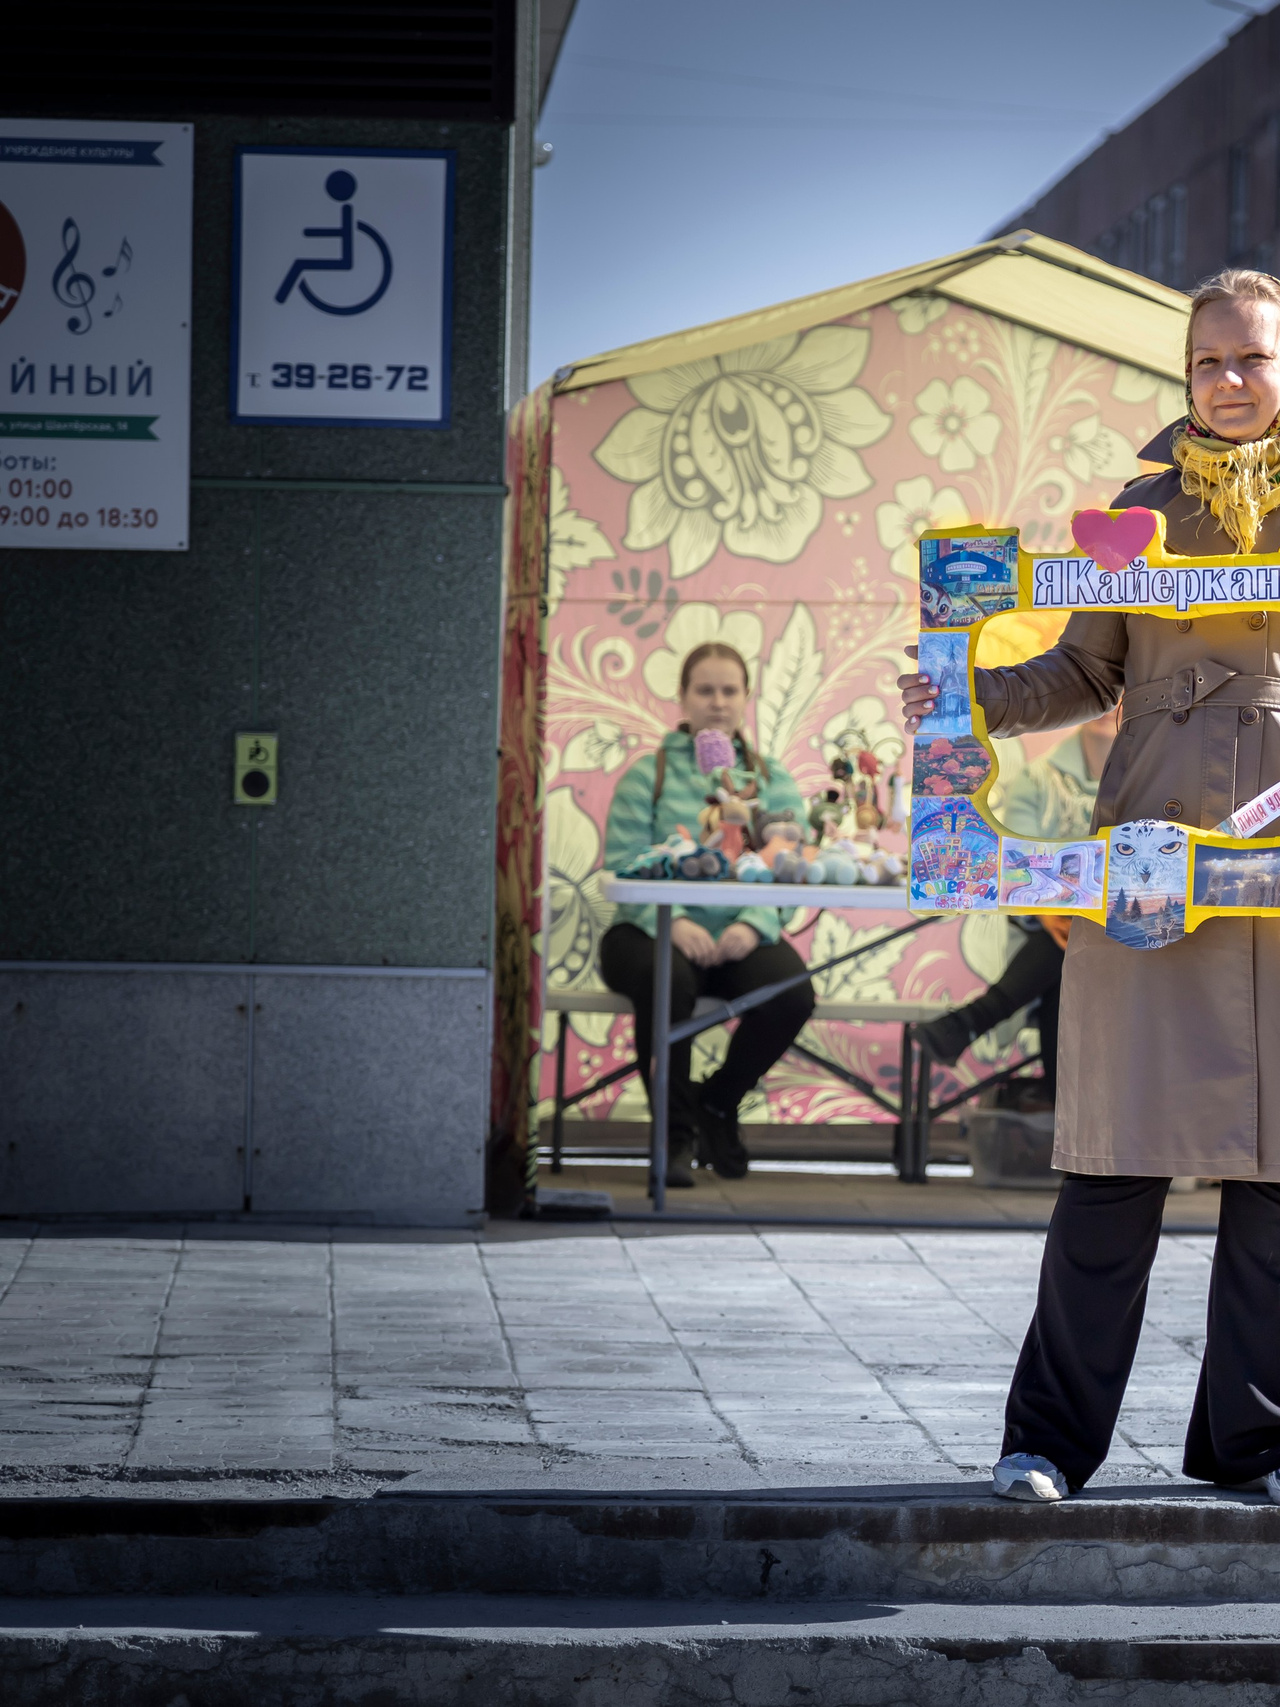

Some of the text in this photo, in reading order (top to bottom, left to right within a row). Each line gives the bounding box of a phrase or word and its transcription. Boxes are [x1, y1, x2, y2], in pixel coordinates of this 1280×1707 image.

[4, 144, 134, 159] УЧРЕЖДЕНИЕ КУЛЬТУРЫ
[272, 363, 428, 391] 39-26-72
[9, 421, 42, 432] улица
[0, 453, 56, 471] оты:
[9, 478, 73, 499] 01:00
[57, 512, 89, 530] до
[97, 508, 158, 528] 18:30
[1237, 801, 1269, 832] ЛИЦА
